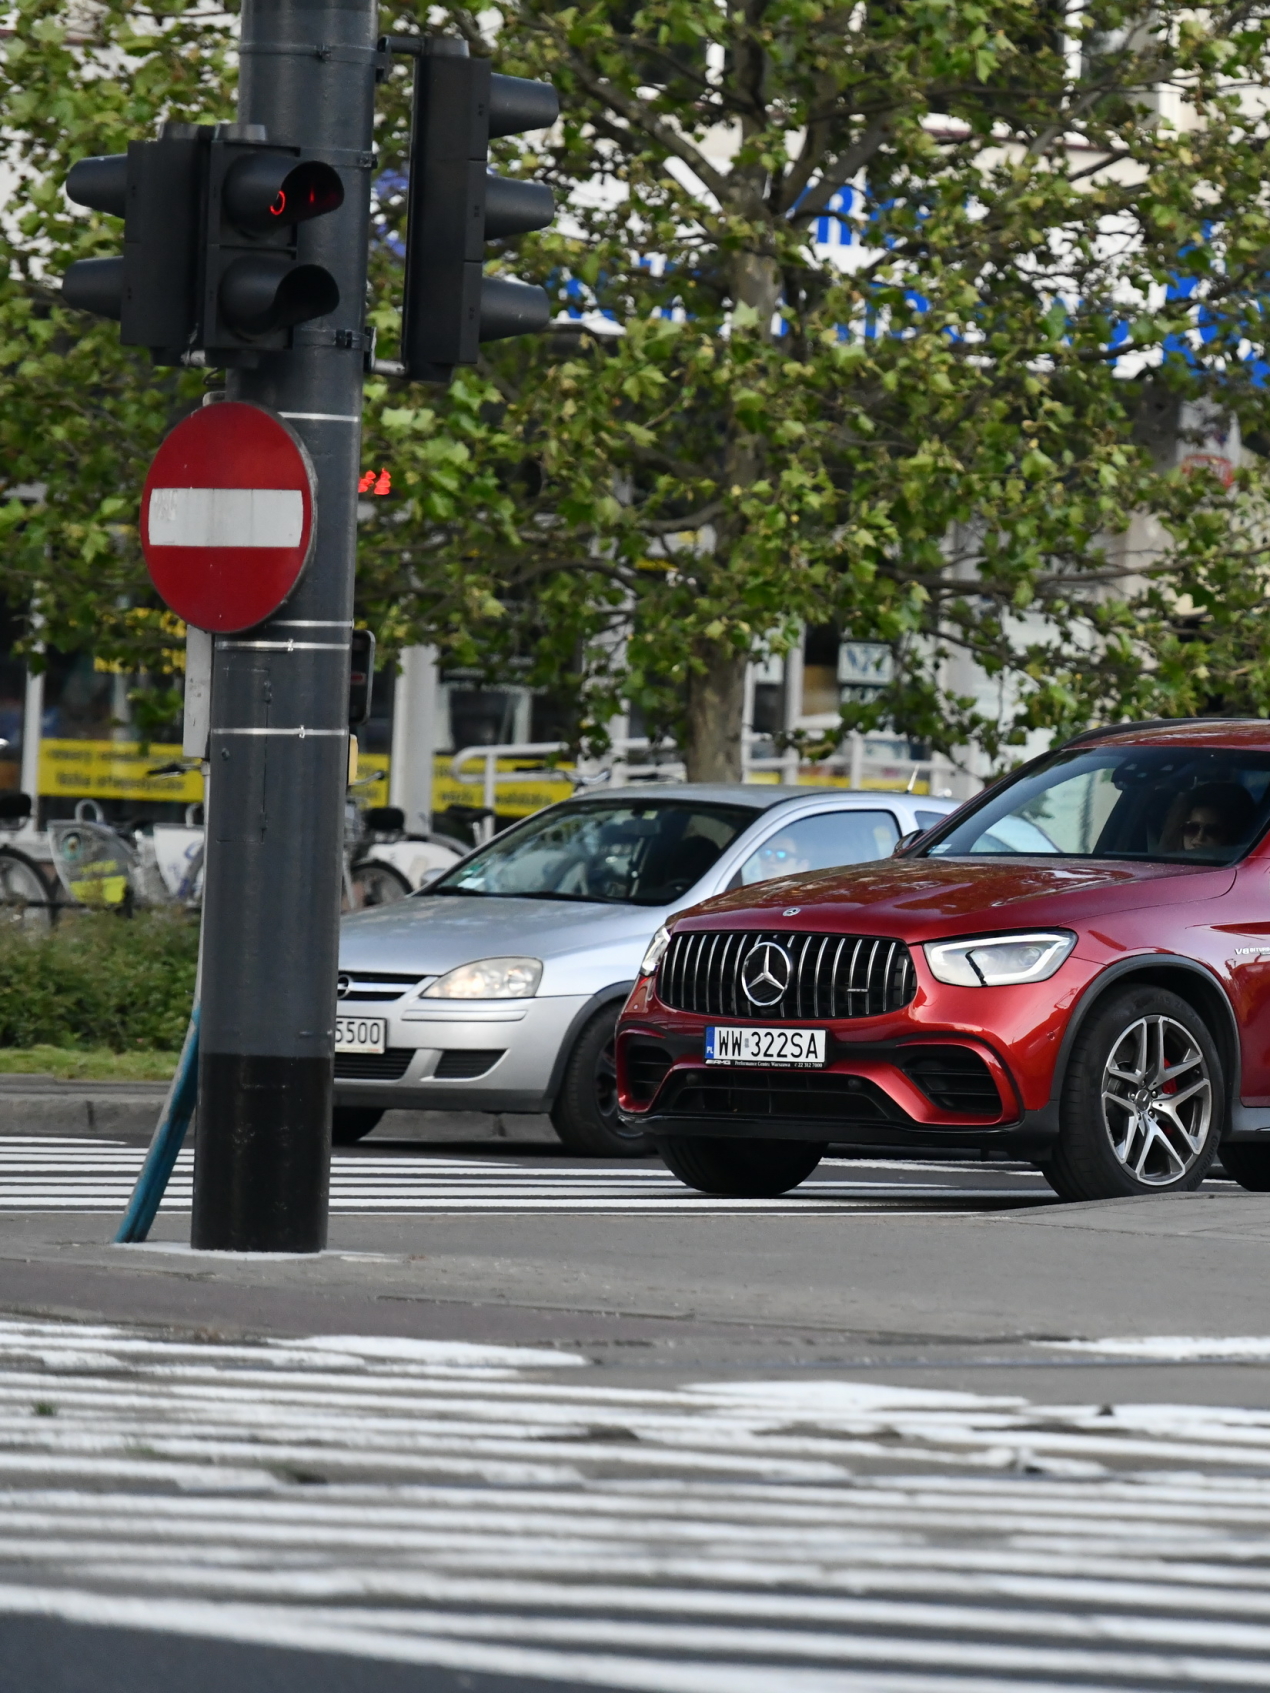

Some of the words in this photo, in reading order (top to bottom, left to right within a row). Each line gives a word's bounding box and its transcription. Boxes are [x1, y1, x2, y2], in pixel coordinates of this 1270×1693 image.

[706, 1046, 714, 1054] PL
[719, 1030, 743, 1057] WW
[751, 1031, 818, 1059] 322SA
